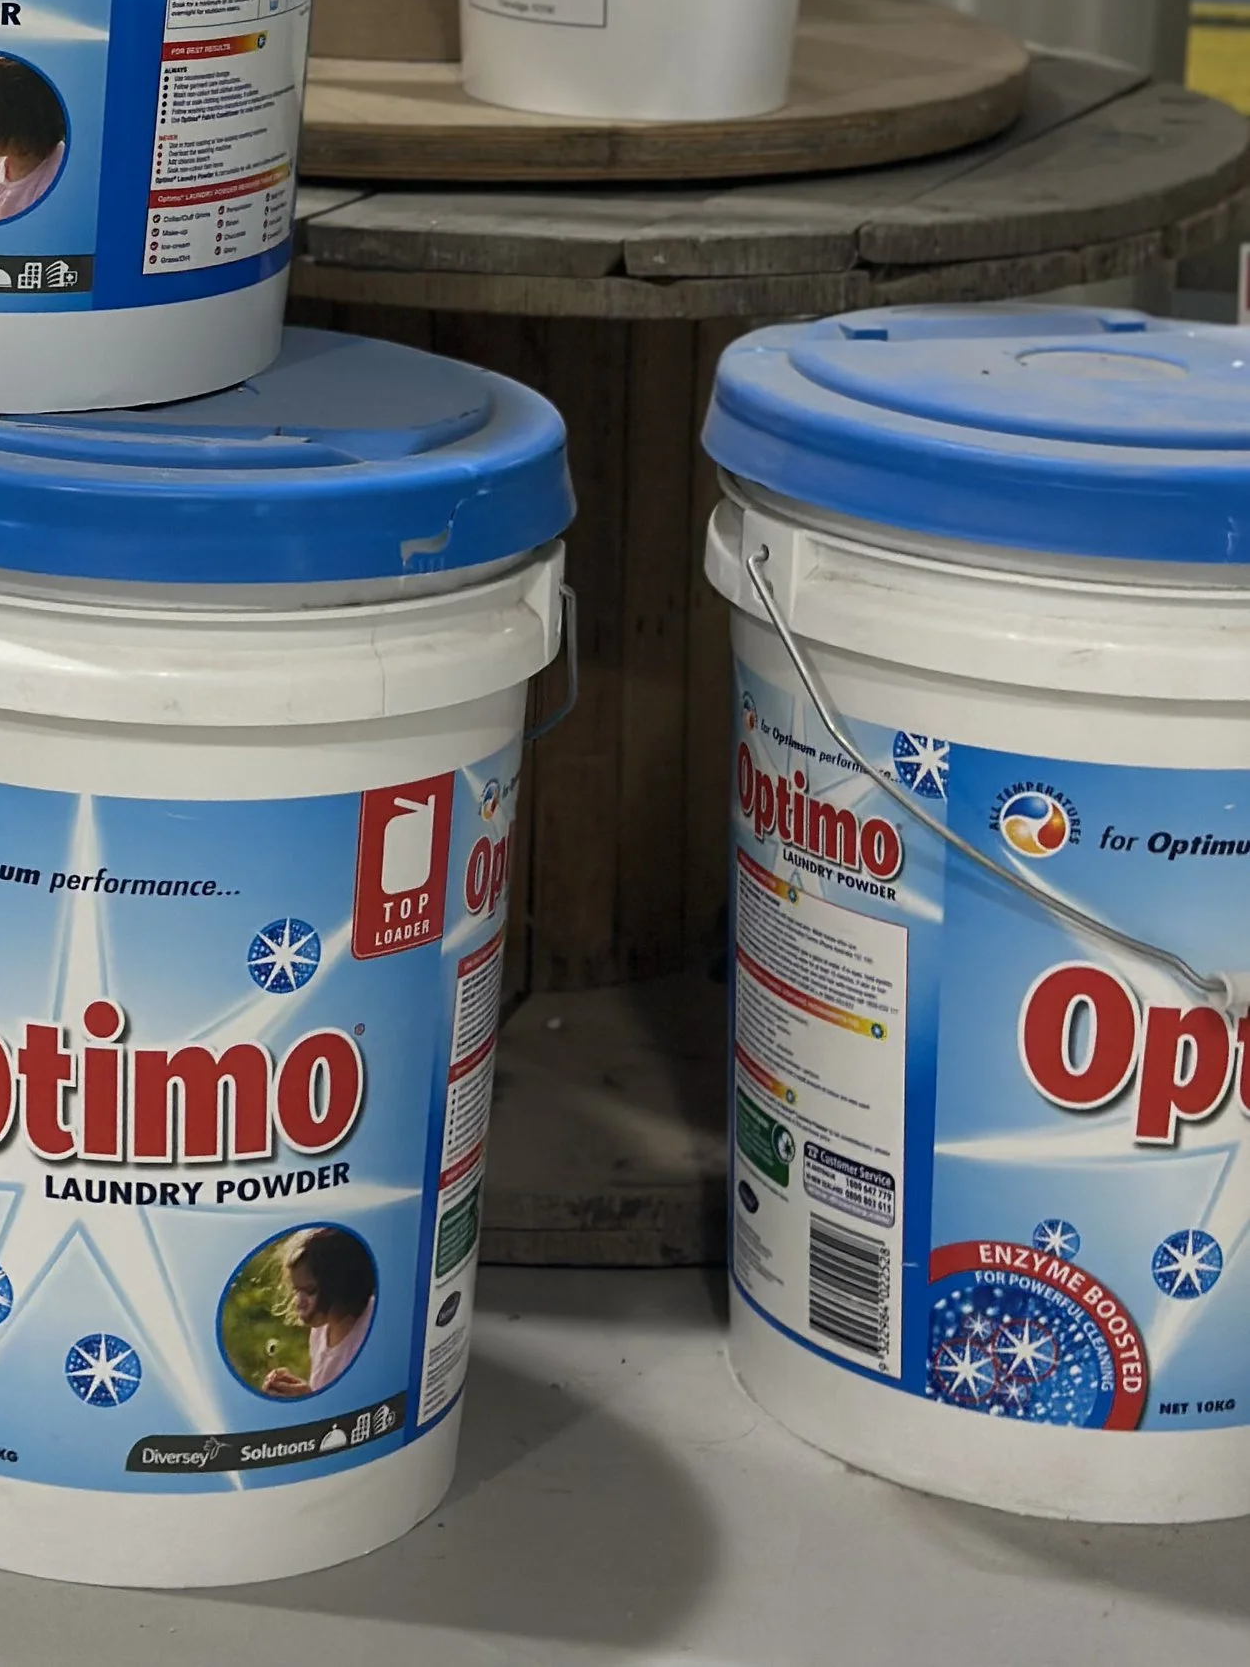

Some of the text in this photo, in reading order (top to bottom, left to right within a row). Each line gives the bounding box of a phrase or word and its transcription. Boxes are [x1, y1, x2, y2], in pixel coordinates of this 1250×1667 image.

[171, 44, 230, 55] FOR BEST RESULTS
[761, 719, 769, 734] for
[772, 727, 817, 758] Optimum
[737, 740, 903, 880] Optimo
[989, 781, 1081, 845] ALL TEMPERATURES
[1099, 825, 1250, 861] for Optimu
[49, 868, 241, 898] performance...
[783, 848, 896, 902] LAUNDRY POWDER
[382, 893, 429, 923] TOP
[374, 919, 431, 947] LOADER
[45, 1162, 350, 1206] LAUNDRY POWDER
[820, 1151, 891, 1187] Customer Service
[975, 1270, 1114, 1392] FOR POWERFUL CLEANING
[979, 1243, 1142, 1394] ENZYME BOOSTED
[1159, 1398, 1236, 1415] NET 10KG
[142, 1439, 316, 1468] Diversey Solutions
